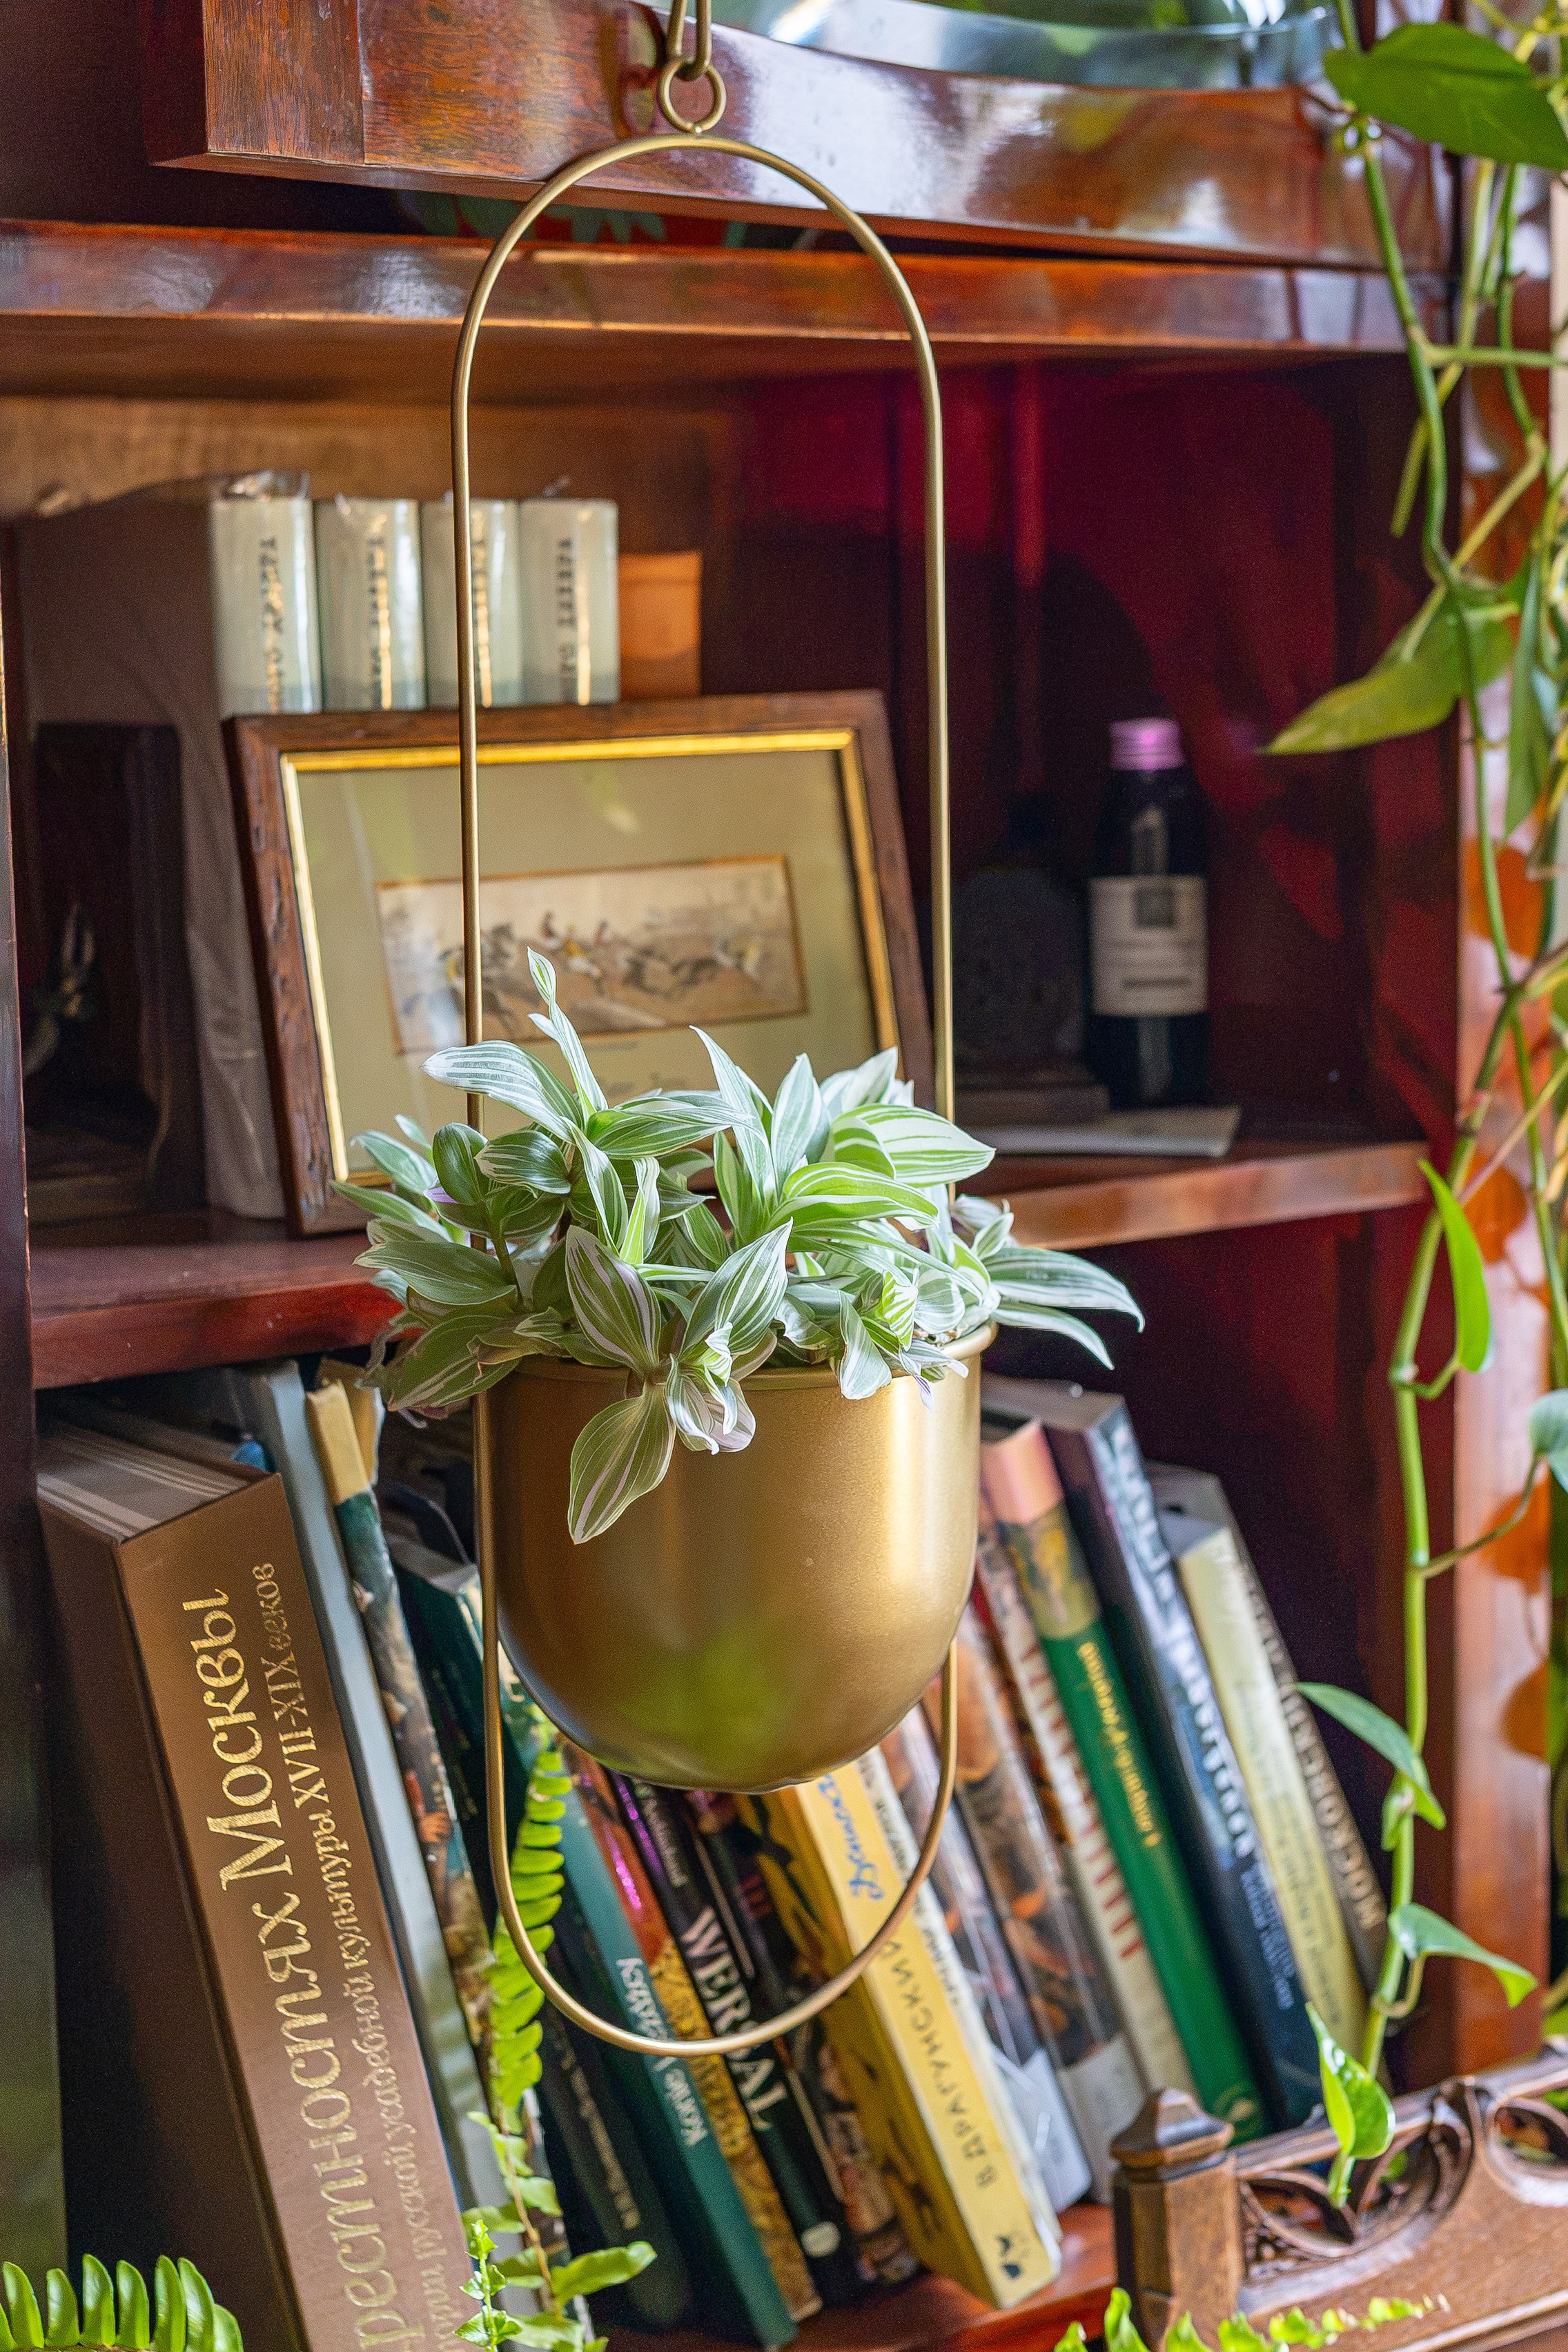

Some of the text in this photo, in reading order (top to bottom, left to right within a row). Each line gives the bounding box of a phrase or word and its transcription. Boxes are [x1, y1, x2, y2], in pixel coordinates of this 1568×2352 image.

[182, 1588, 427, 2352] рестностях Москвы
[251, 1562, 469, 2352] ории русской усадебной культуры XVII-XIX веков
[878, 1939, 988, 2159] ДРАГУНСКИЙ
